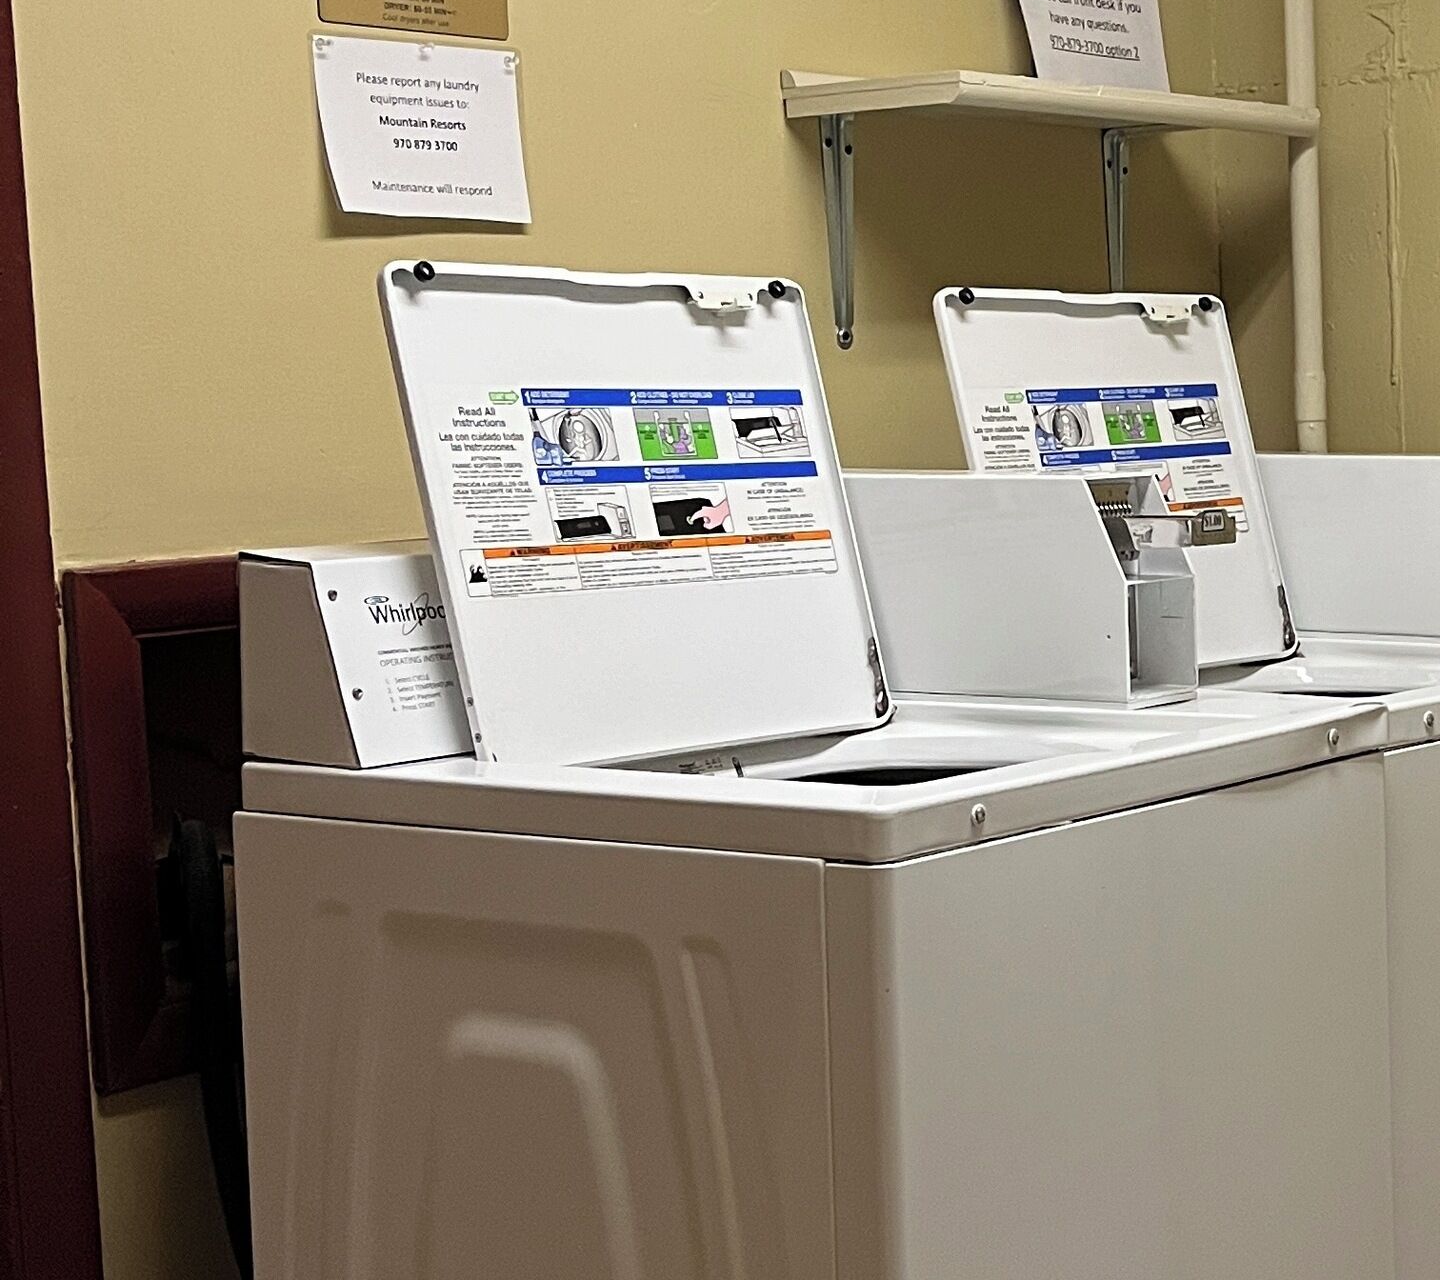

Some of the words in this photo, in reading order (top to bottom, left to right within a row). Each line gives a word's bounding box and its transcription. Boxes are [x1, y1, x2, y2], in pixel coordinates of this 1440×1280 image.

[1125, 2, 1141, 15] you
[1049, 10, 1069, 25] have
[1071, 17, 1085, 30] any
[1106, 45, 1132, 57] option
[356, 72, 388, 86] Please
[390, 77, 421, 89] report
[424, 80, 441, 91] any
[443, 78, 480, 92] laundry
[370, 94, 423, 107] equipment
[426, 97, 454, 108] issues
[379, 115, 428, 129] Mountain
[430, 119, 466, 131] Resorts
[393, 138, 412, 149] 970
[414, 139, 432, 150] 879
[435, 139, 458, 151] 3700
[372, 180, 434, 194] Maintenance
[437, 183, 452, 194] will
[454, 185, 493, 196] respond
[458, 406, 482, 416] Read
[485, 407, 496, 415] All
[452, 418, 506, 427] Instructions
[439, 432, 453, 441] Lea
[471, 433, 501, 441] cuidado
[503, 433, 524, 441] todas
[368, 602, 446, 626] Whirlpoo
